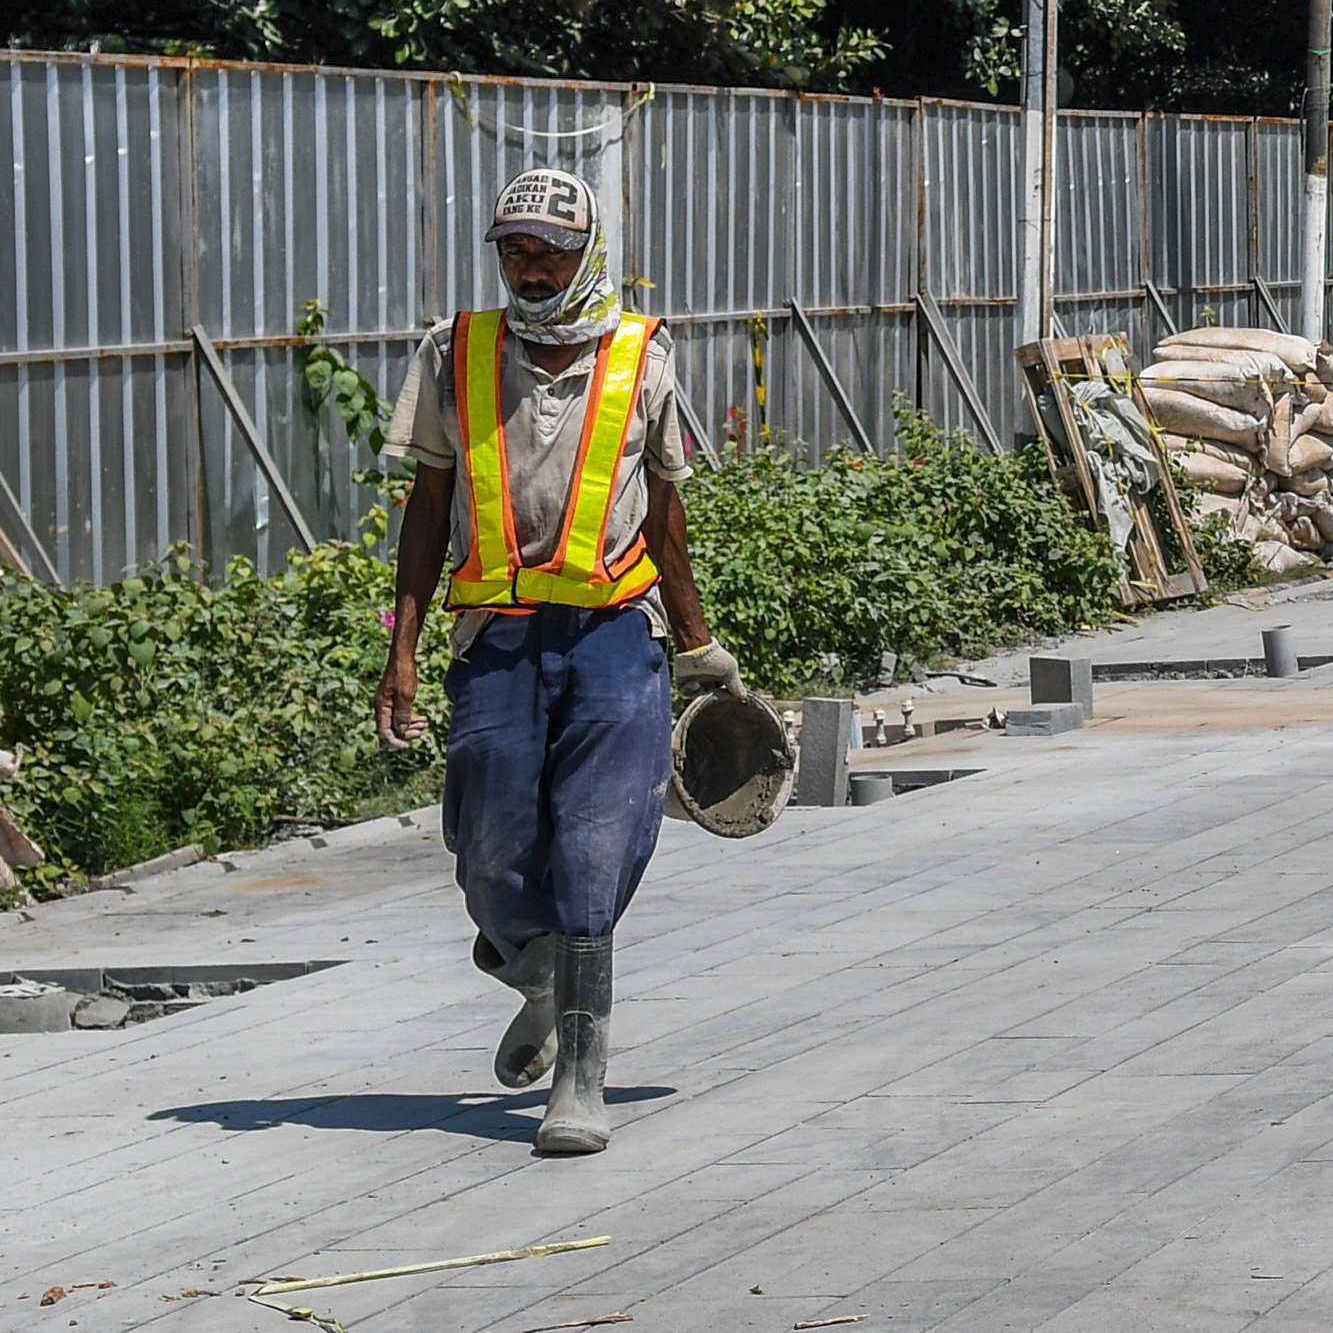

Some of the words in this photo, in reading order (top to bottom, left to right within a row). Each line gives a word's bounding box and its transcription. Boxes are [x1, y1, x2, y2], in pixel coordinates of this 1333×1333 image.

[504, 194, 546, 206] AKU
[547, 177, 578, 223] 2
[526, 204, 542, 214] KE
